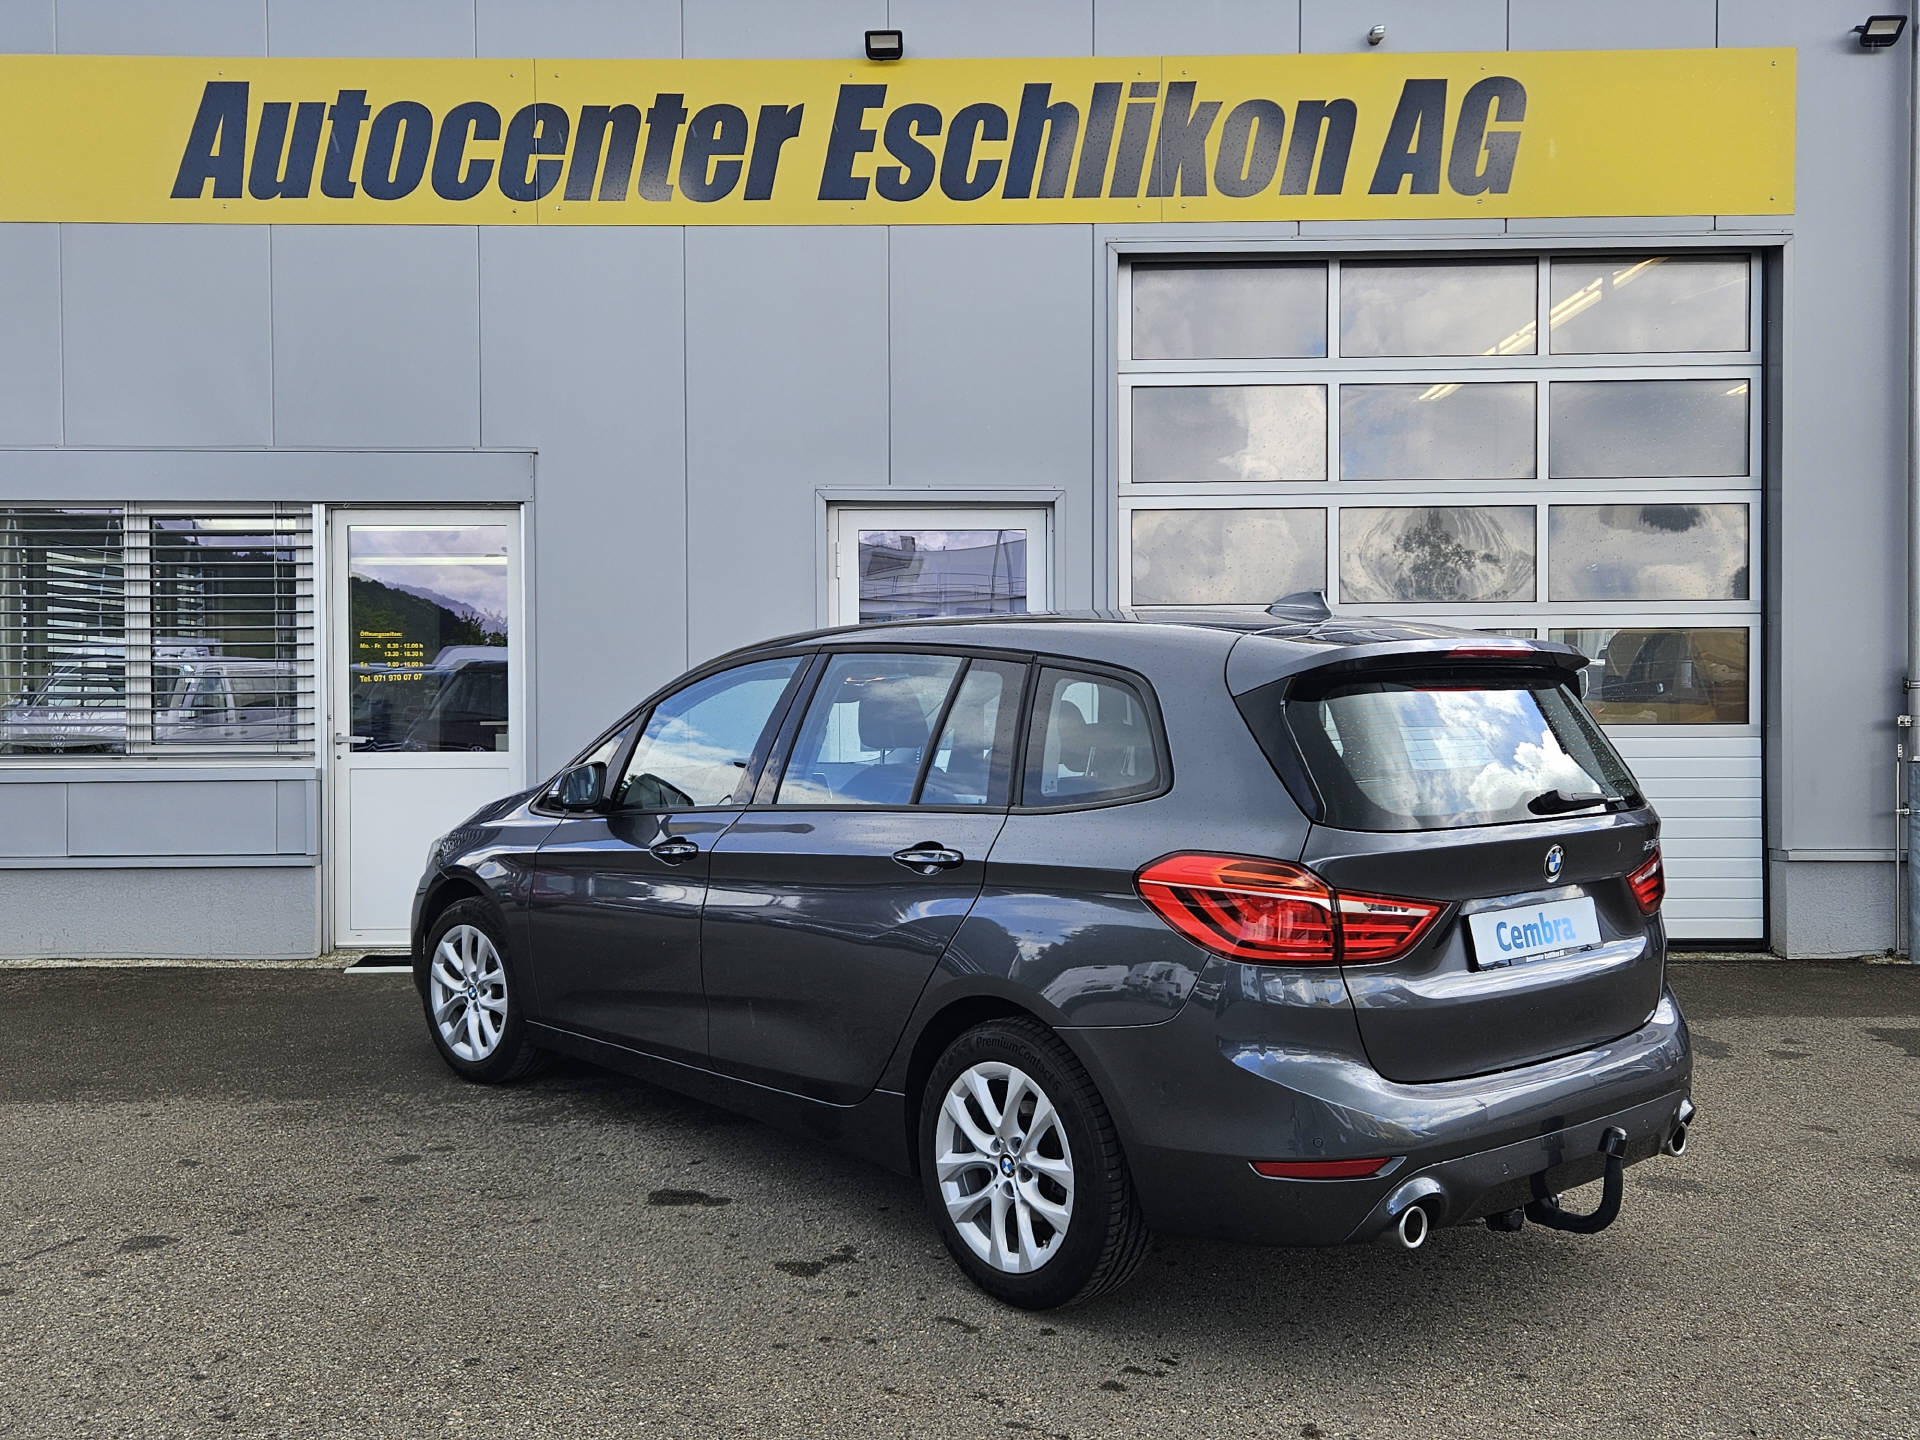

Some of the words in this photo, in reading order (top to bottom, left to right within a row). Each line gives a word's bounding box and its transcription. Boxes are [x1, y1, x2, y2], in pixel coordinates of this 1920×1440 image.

[170, 81, 804, 202] Autocenter
[818, 81, 1357, 202] Eschlikon
[1368, 76, 1527, 198] AG
[373, 674, 386, 682] 071
[1496, 912, 1577, 952] Cembra
